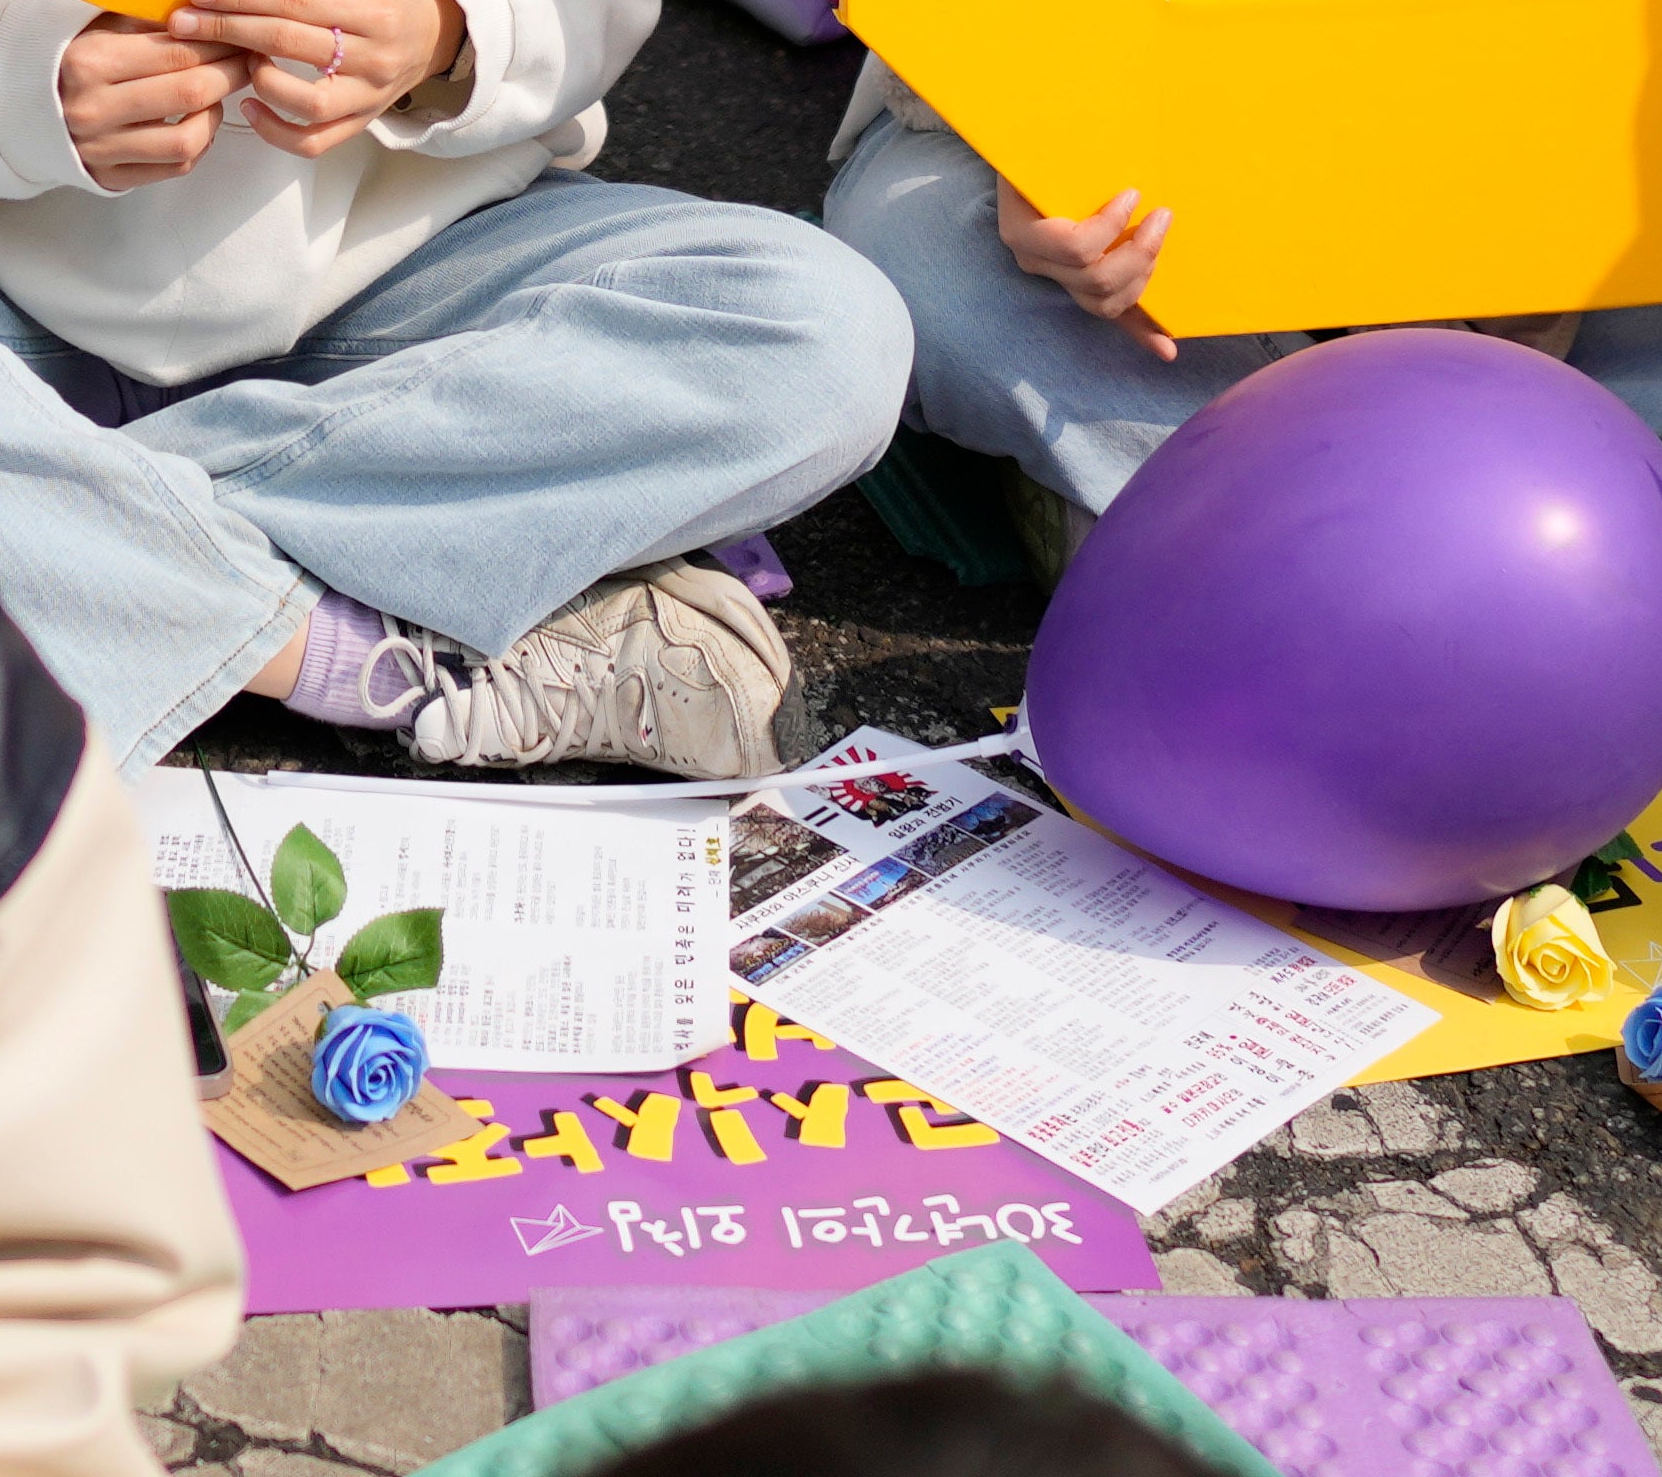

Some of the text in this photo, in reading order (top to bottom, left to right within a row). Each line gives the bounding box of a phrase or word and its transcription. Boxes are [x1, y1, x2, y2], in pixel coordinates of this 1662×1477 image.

[675, 827, 695, 861] 없다!
[676, 872, 695, 912] 미래가
[675, 925, 695, 964] 민족은
[675, 978, 694, 1004] 잊은
[607, 1193, 1083, 1257] 30년간의 외침
